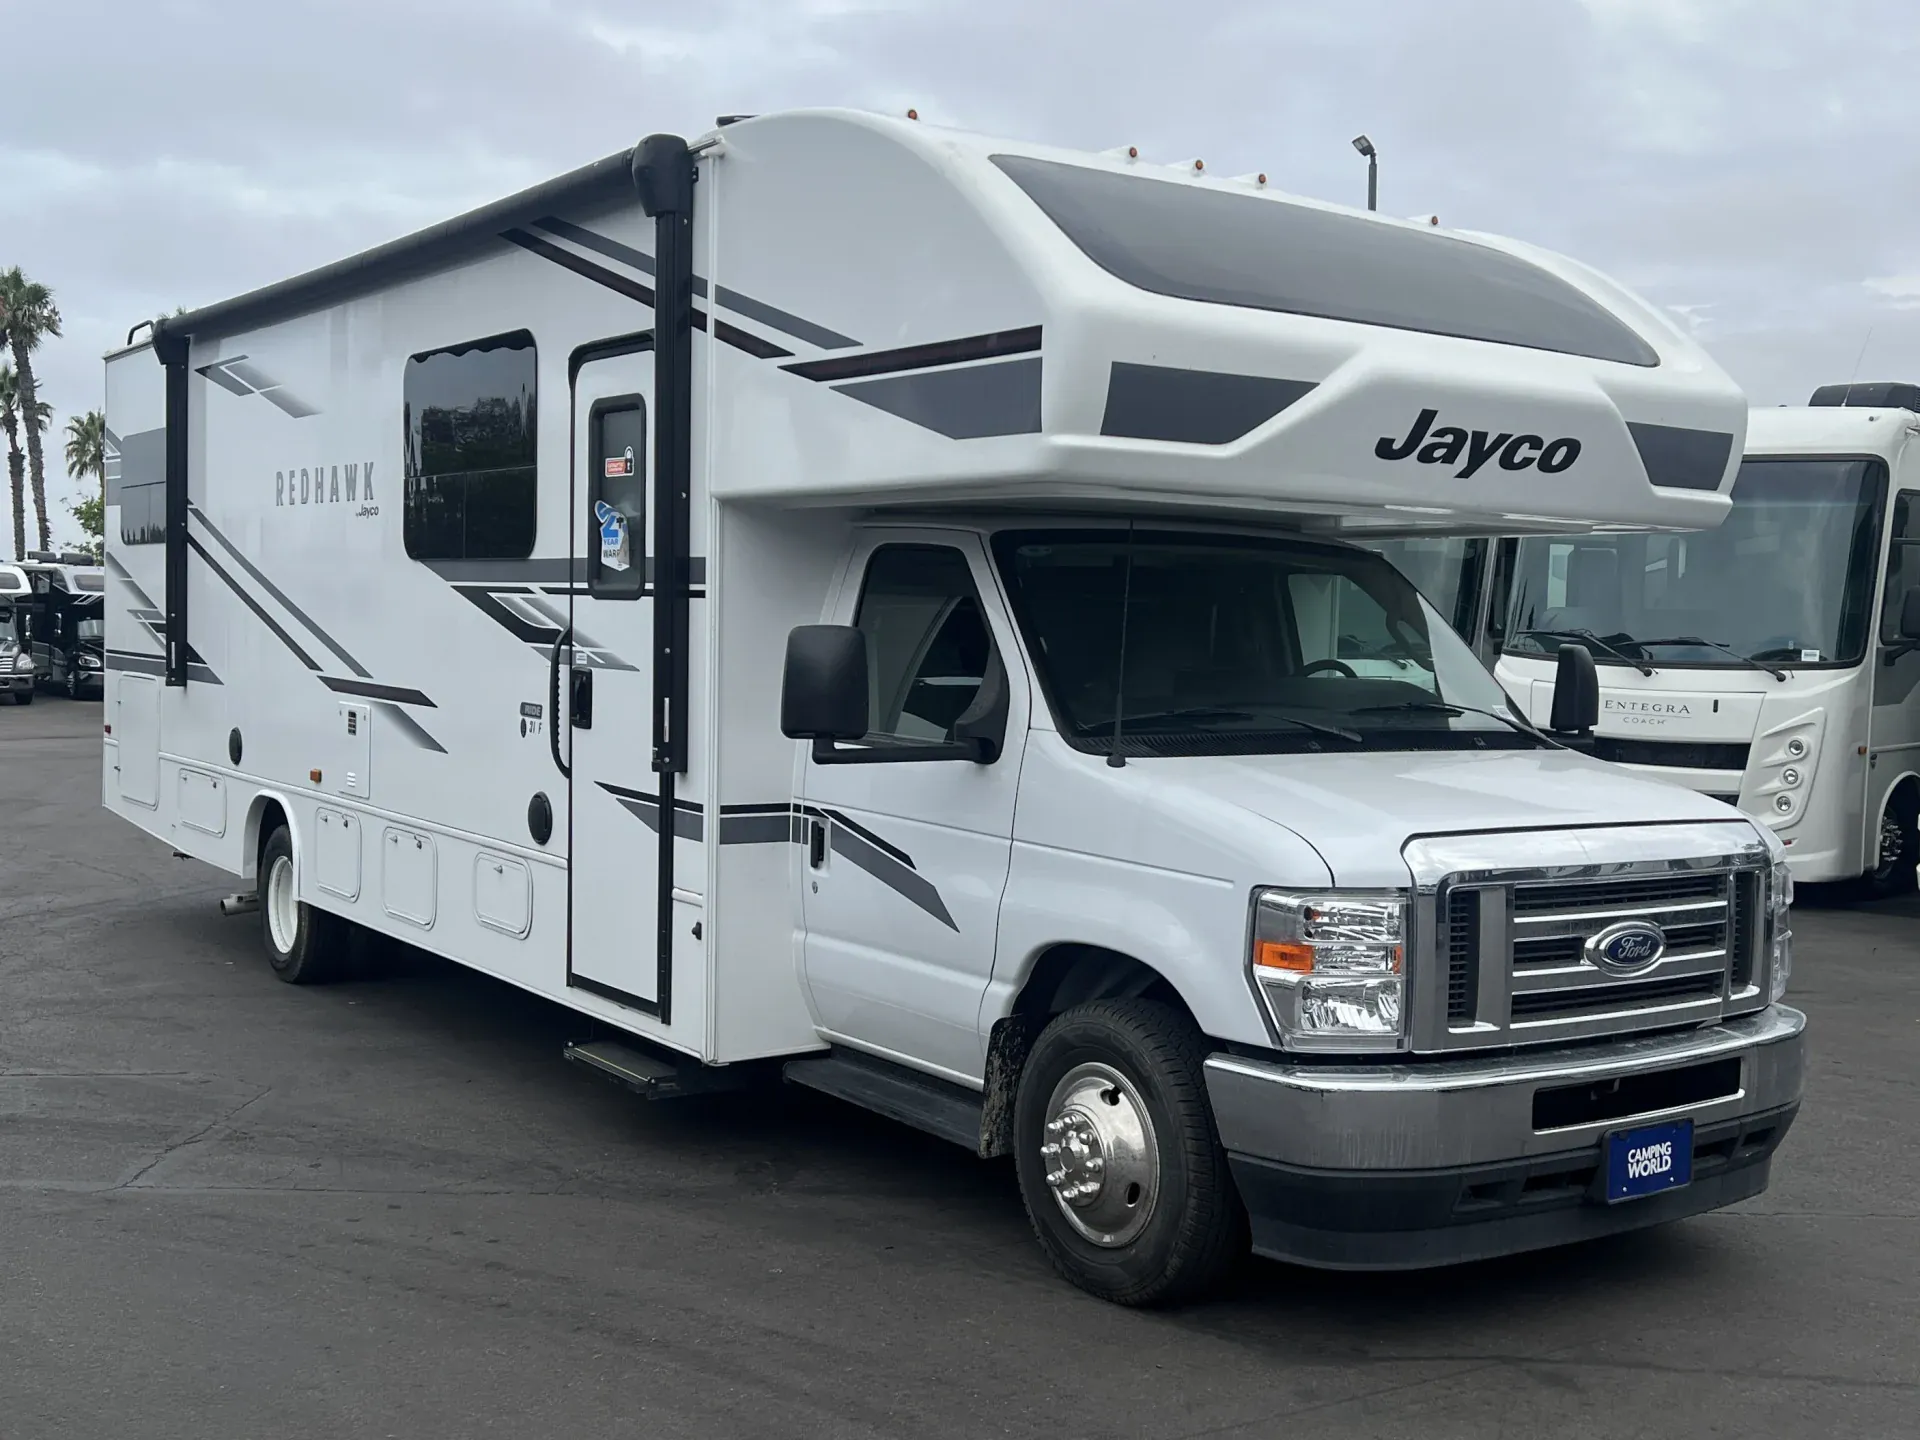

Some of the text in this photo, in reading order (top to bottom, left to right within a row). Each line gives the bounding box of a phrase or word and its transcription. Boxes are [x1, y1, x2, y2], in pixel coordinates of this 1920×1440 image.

[1375, 408, 1581, 479] Jayco
[276, 461, 374, 507] REDHAWK
[358, 504, 379, 519] Jayco
[1604, 700, 1691, 714] ENTEGRA
[1623, 716, 1666, 725] COACH
[1617, 936, 1652, 958] Ford
[1628, 1141, 1672, 1163] CAMPING
[1628, 1155, 1672, 1179] WORLD
